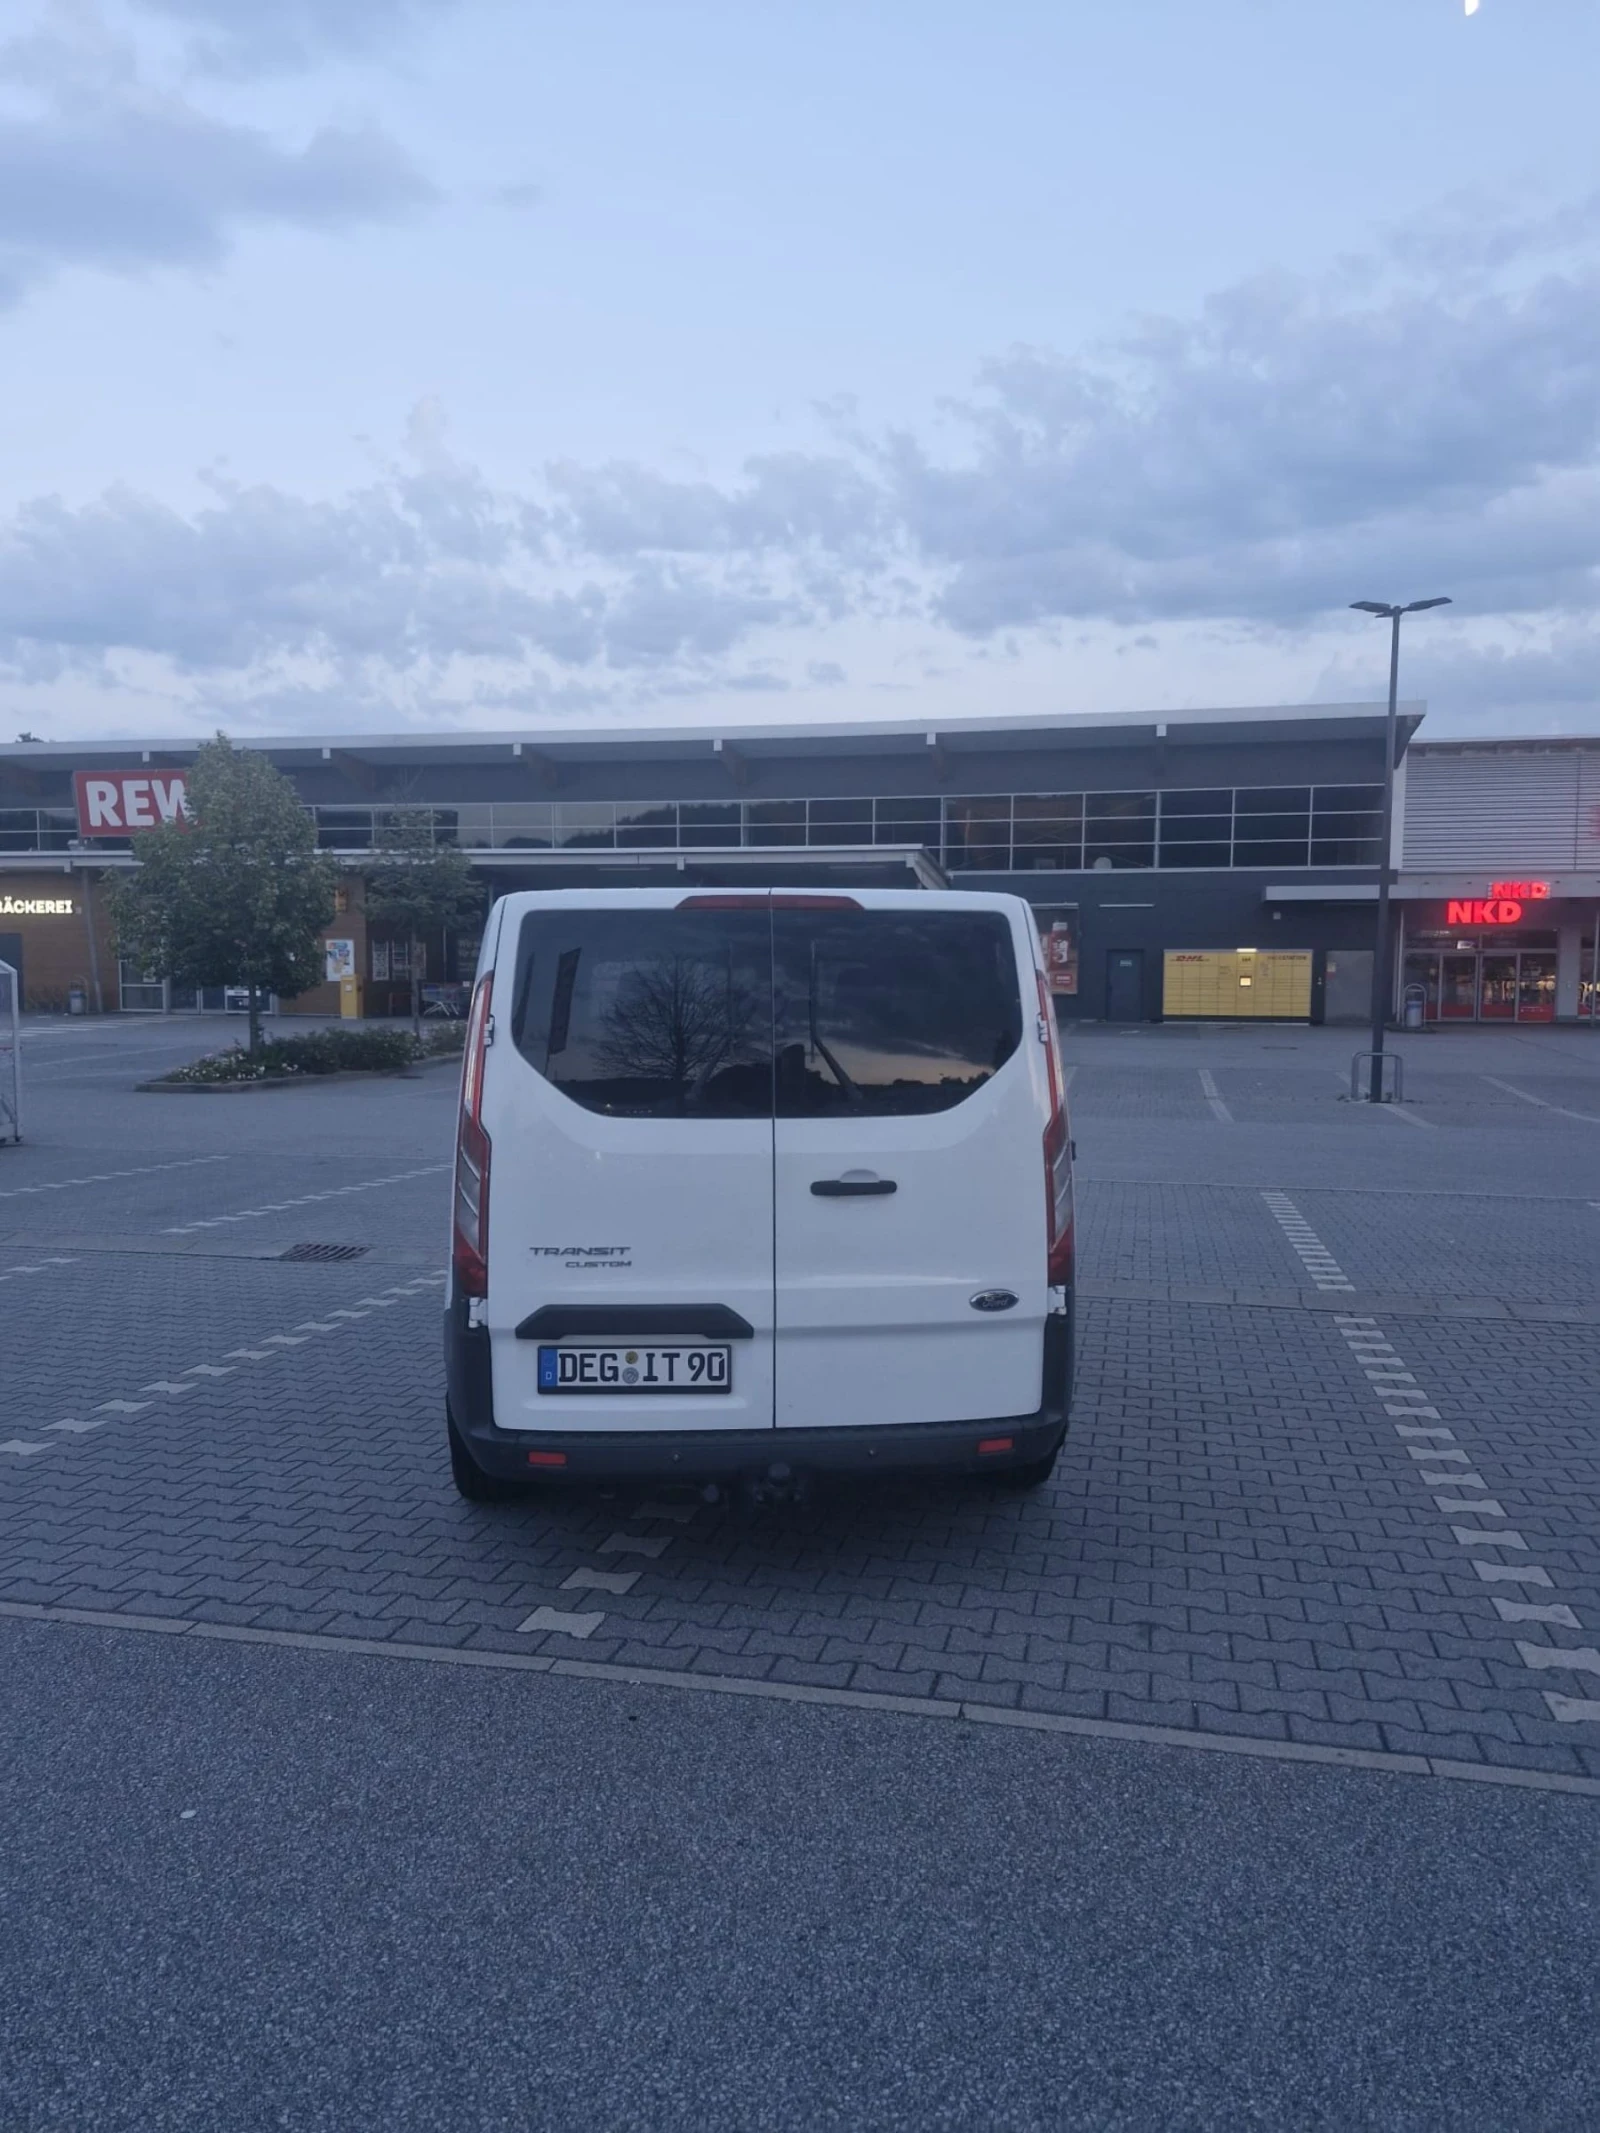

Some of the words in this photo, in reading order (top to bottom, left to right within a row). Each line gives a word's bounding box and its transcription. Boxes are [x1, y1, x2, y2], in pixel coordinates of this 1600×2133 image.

[86, 779, 197, 827] REW
[1489, 882, 1549, 899] NKD
[0, 896, 73, 913] ÄCKEREI
[1448, 901, 1522, 923] NKD
[529, 1247, 632, 1256] TRANSIT
[558, 1353, 619, 1382] DEG
[643, 1352, 681, 1382] IT
[687, 1352, 725, 1382] 90
[545, 1372, 552, 1380] D
